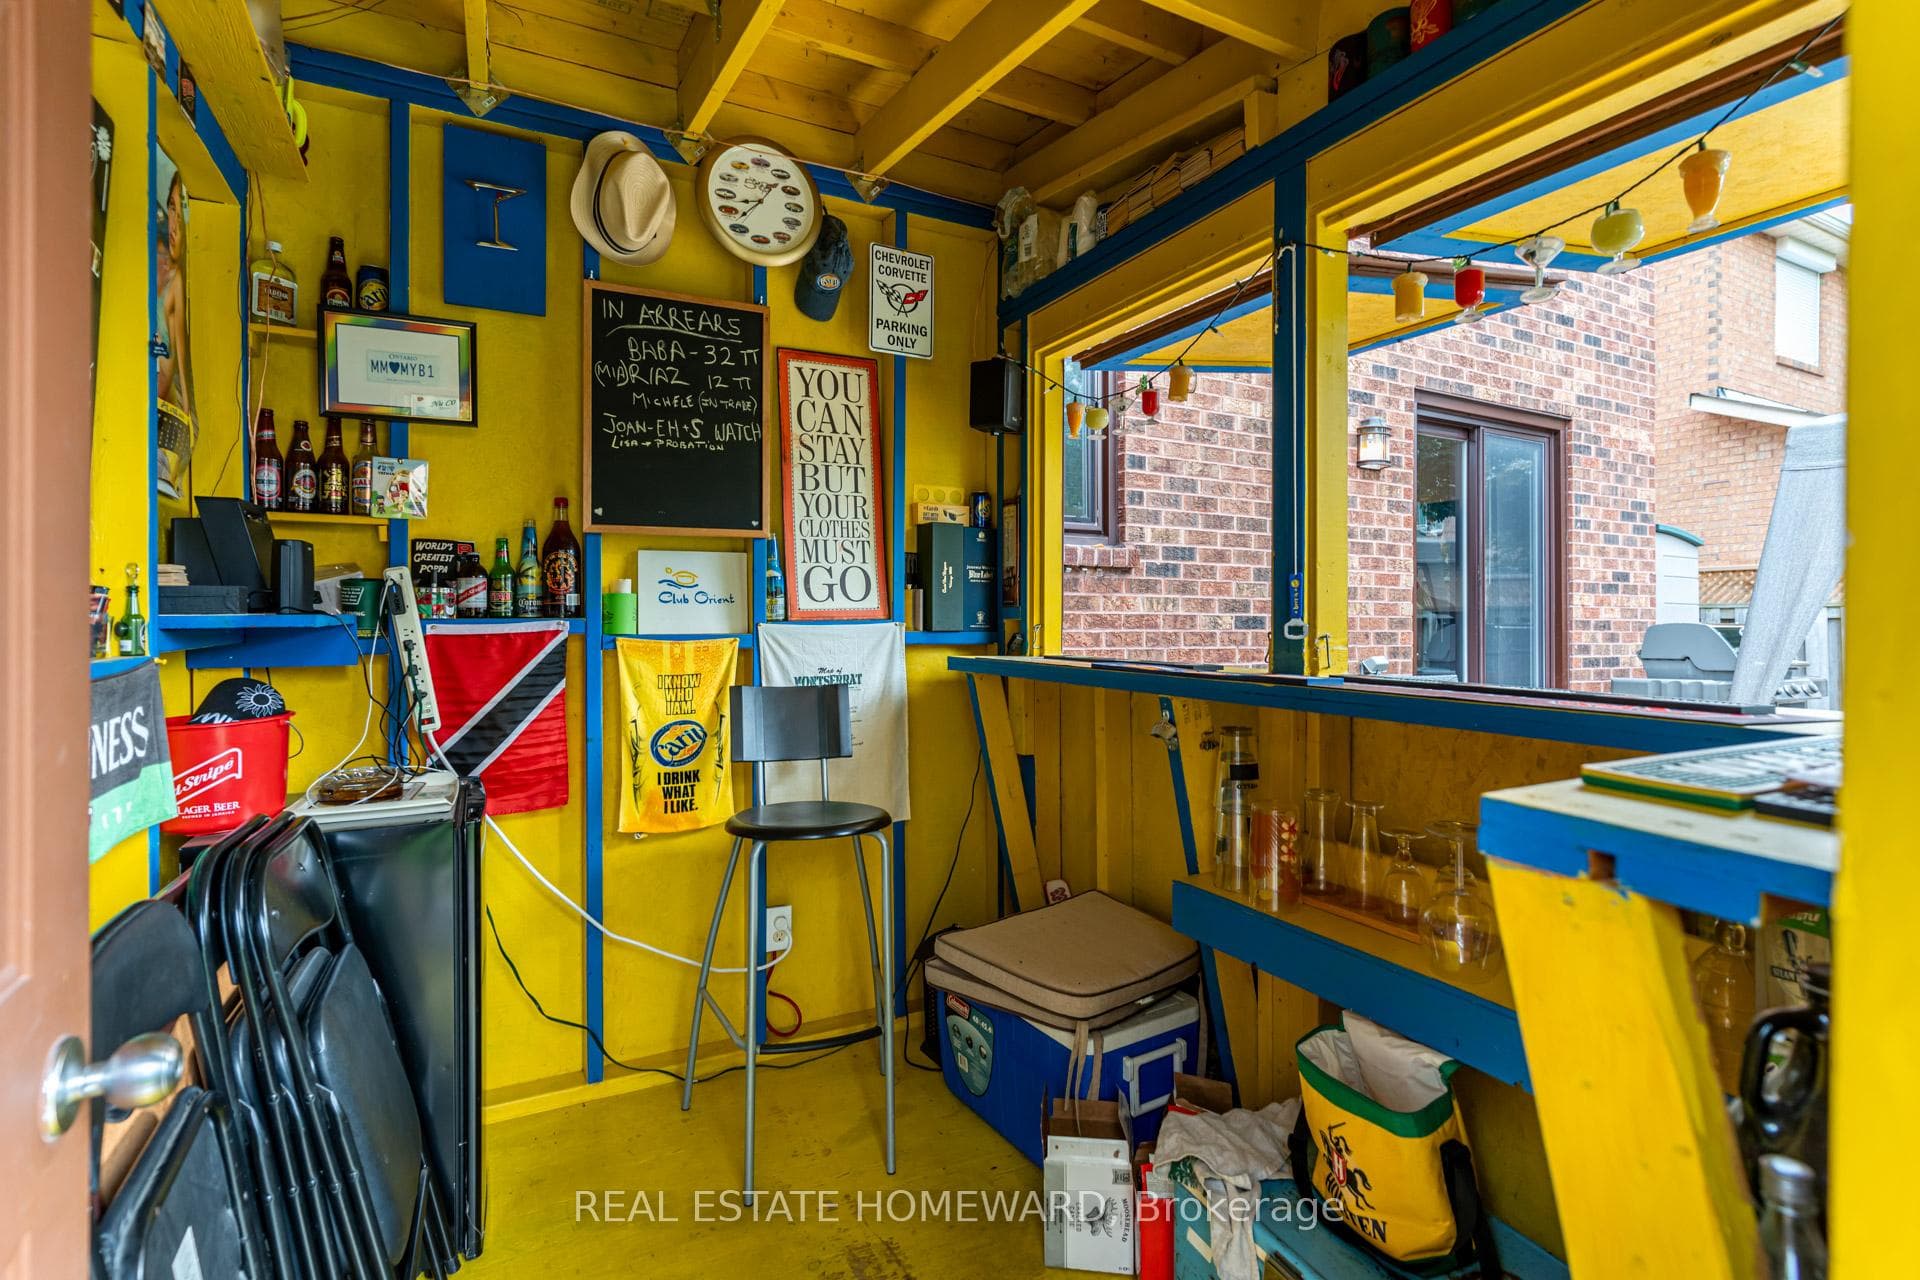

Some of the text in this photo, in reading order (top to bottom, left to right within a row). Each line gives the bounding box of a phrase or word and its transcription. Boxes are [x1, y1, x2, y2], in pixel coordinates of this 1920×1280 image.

[875, 250, 930, 271] CHEVROLET
[878, 265, 927, 284] CORVETTE
[603, 298, 741, 335] IN ARREARS
[876, 319, 928, 337] PARKING
[887, 334, 917, 349] ONLY
[704, 345, 735, 366] 32
[629, 363, 690, 386] RIAZ
[708, 375, 728, 389] 12
[795, 367, 864, 403] YOU
[796, 399, 865, 437] CAN
[715, 423, 762, 442] WATCH
[799, 433, 867, 466] STAY
[800, 463, 866, 494] BUT
[799, 493, 870, 520] YOUR
[799, 519, 871, 539] CLOTHES
[415, 541, 454, 551] WORLD'S
[801, 538, 871, 564] MUST
[413, 553, 455, 564] GREATEST
[419, 564, 448, 574] POPPA
[803, 565, 872, 602] GO
[658, 591, 735, 605] Club Orient
[658, 673, 701, 689] I KNOW
[794, 674, 863, 686] MONTSERRAT
[664, 687, 693, 702] WHO
[666, 702, 671, 715] I
[183, 758, 234, 791] Stripe
[657, 770, 700, 785] I DRINK
[662, 784, 696, 799] WHAT
[177, 801, 240, 815] LAGER BEER
[664, 799, 699, 814] I LIKE.
[1121, 1198, 1131, 1243] MOOSEHEAD
